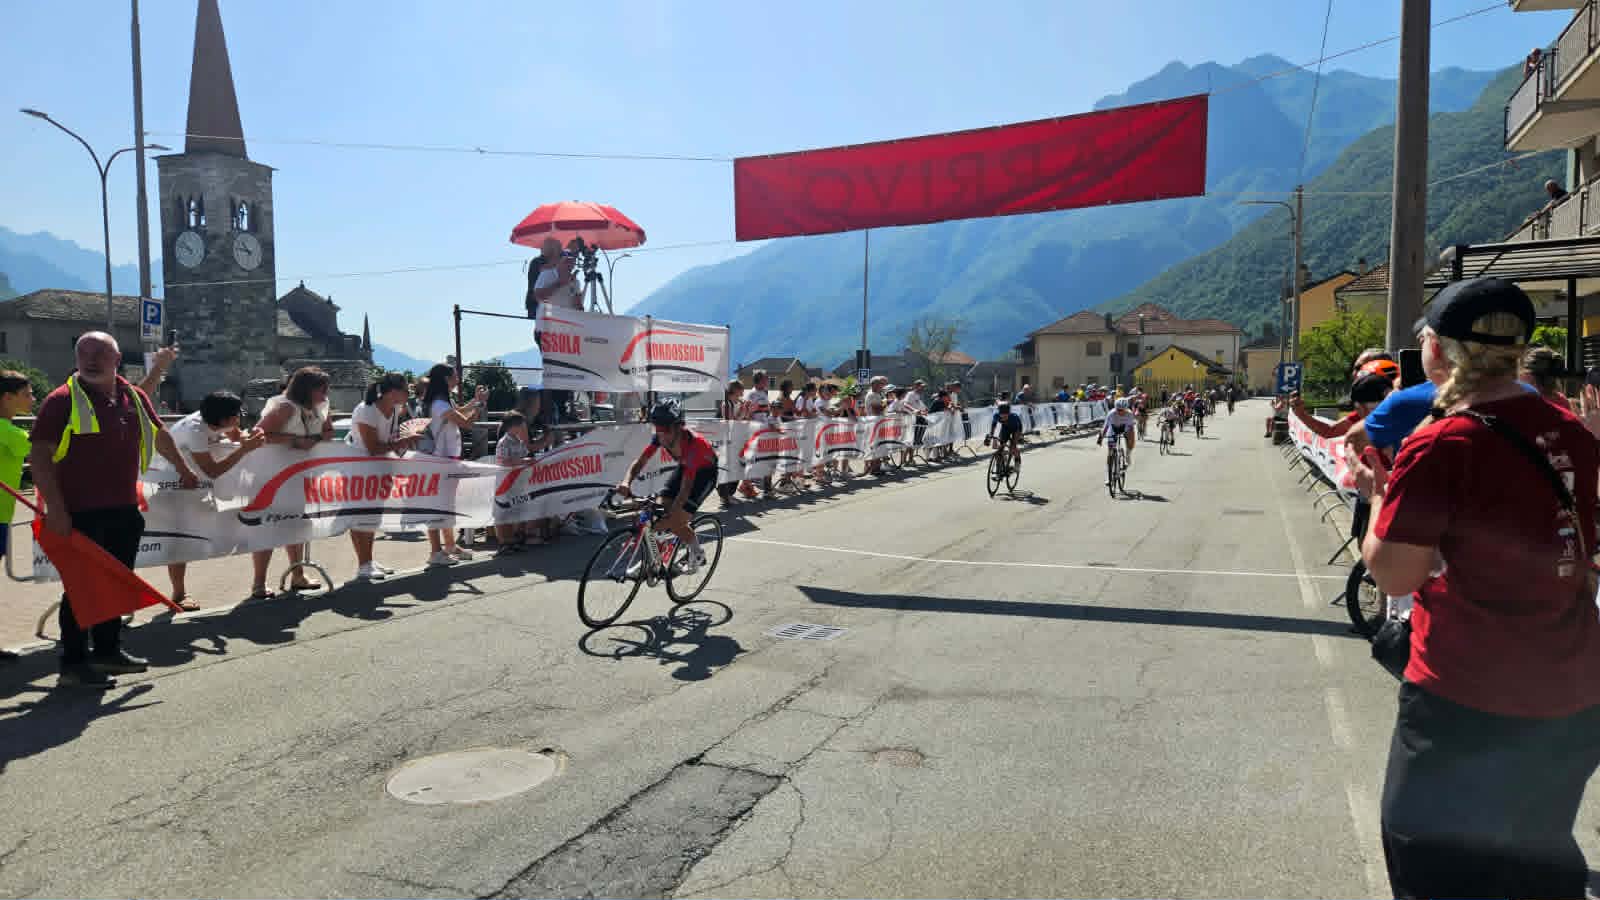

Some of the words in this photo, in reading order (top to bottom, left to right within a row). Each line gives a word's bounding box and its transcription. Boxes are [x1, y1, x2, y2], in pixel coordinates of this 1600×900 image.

[147, 303, 158, 321] P
[645, 342, 705, 363] NORDOSSOLA
[1284, 365, 1297, 382] P
[528, 453, 603, 485] NORDOSSOLA
[304, 473, 441, 504] NORDOSSOLA
